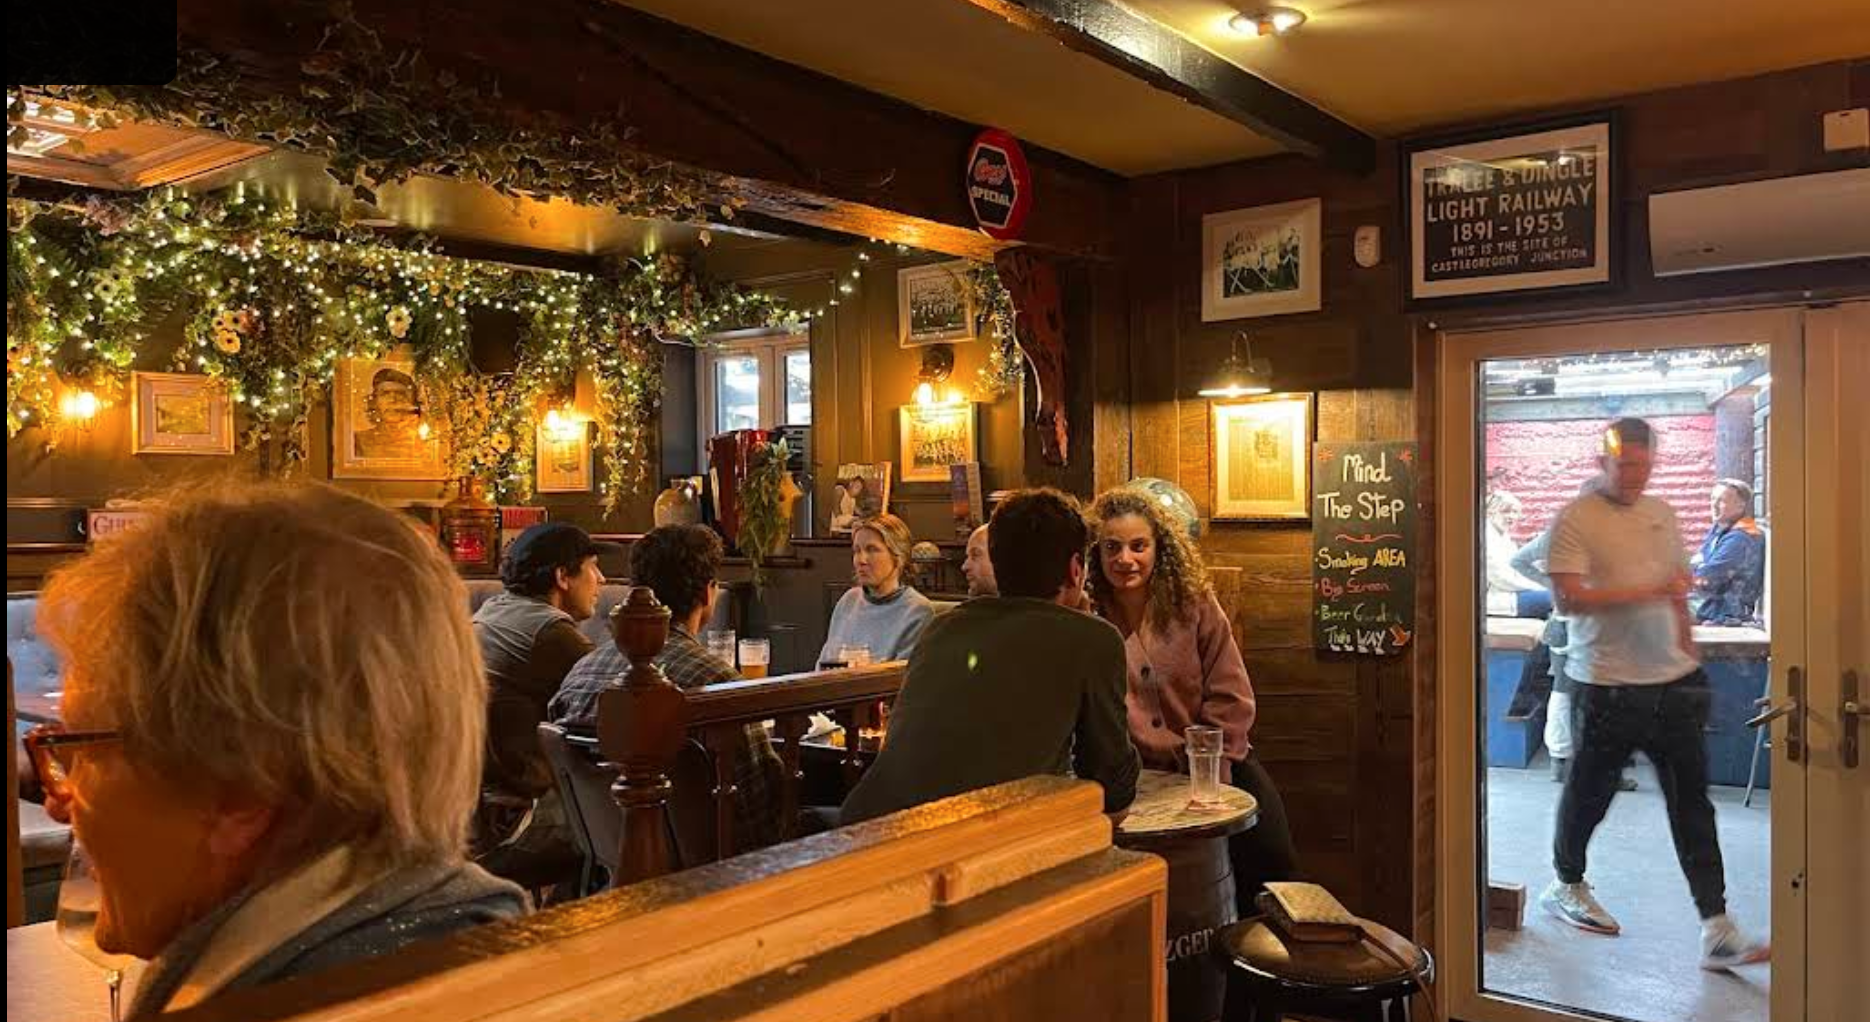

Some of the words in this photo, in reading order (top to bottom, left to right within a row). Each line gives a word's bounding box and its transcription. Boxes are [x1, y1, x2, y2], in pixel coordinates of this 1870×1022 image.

[1502, 168, 1516, 187] &
[1521, 156, 1594, 184] DINGLE
[1427, 197, 1489, 222] LIGHT
[1499, 183, 1593, 213] RAILWAY
[1453, 221, 1493, 243] 1891
[1515, 212, 1565, 236] 1953
[1451, 244, 1475, 258] THIS
[1481, 243, 1493, 255] IS
[1497, 240, 1517, 253] THE
[1523, 237, 1549, 250] SITE
[1553, 235, 1568, 247] OF
[1343, 452, 1392, 483] Mind
[1317, 491, 1353, 519] The
[1318, 547, 1369, 575] Smoking
[1372, 547, 1406, 568] AREA
[1320, 578, 1344, 602] Big
[1320, 604, 1351, 621] Beer
[1356, 628, 1386, 648] WAY
